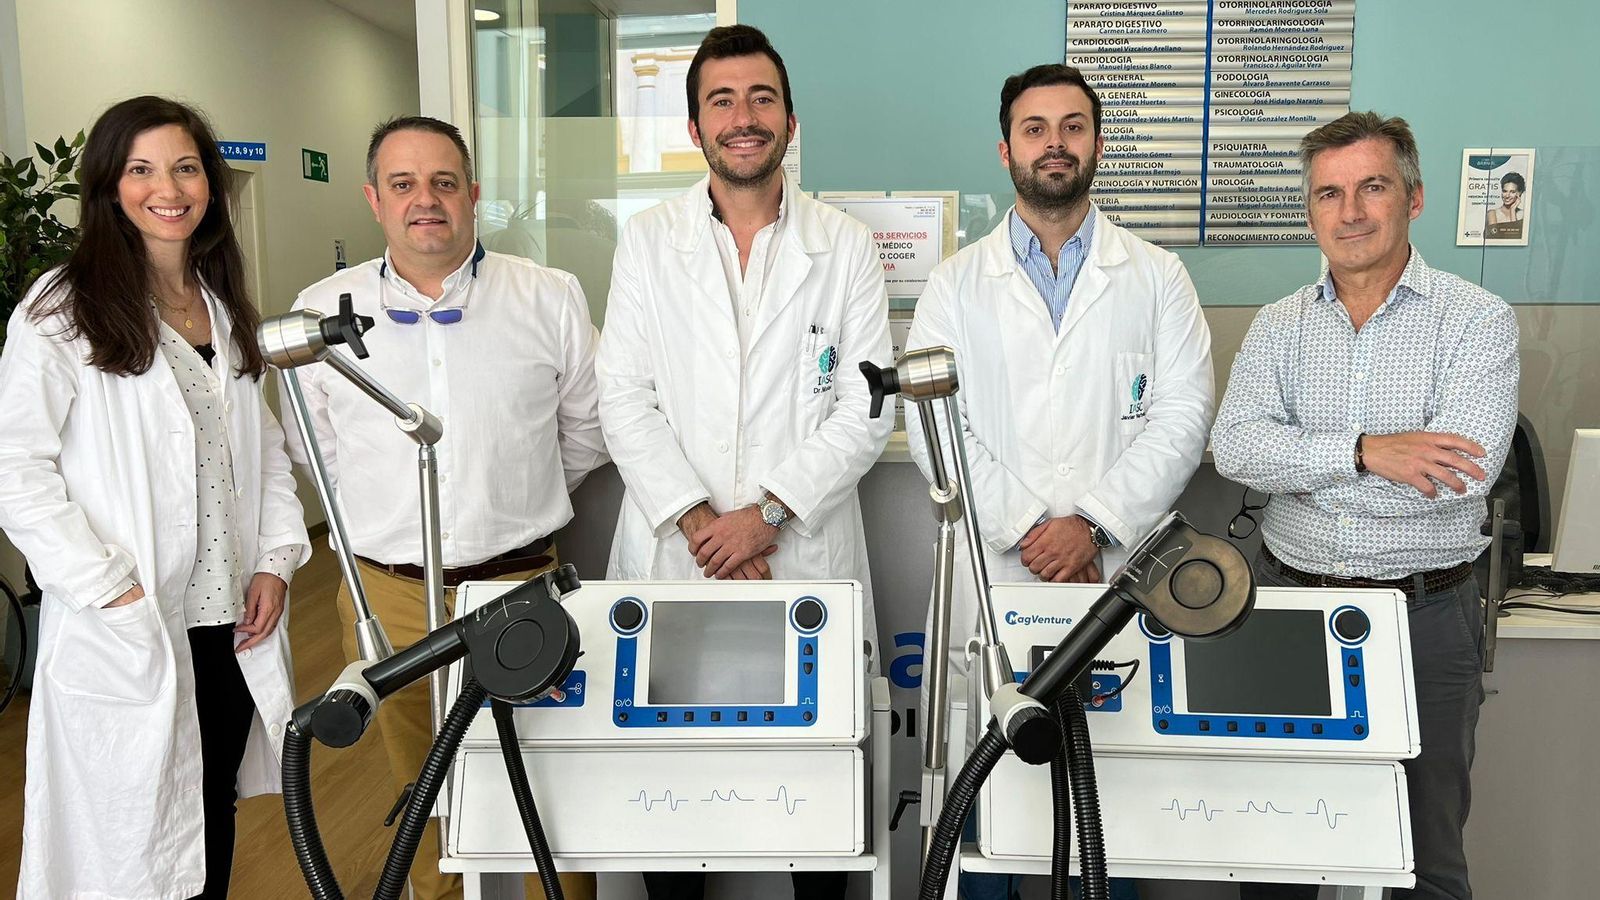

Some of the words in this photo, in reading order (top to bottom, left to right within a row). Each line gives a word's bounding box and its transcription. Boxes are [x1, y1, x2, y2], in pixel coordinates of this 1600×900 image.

[1219, 1, 1332, 9] OTORRINOLARINGOLOGIA
[1217, 73, 1269, 81] PODOLOGIA
[1152, 178, 1197, 186] NUTRICIÓN
[1005, 610, 1072, 626] MagVenture
